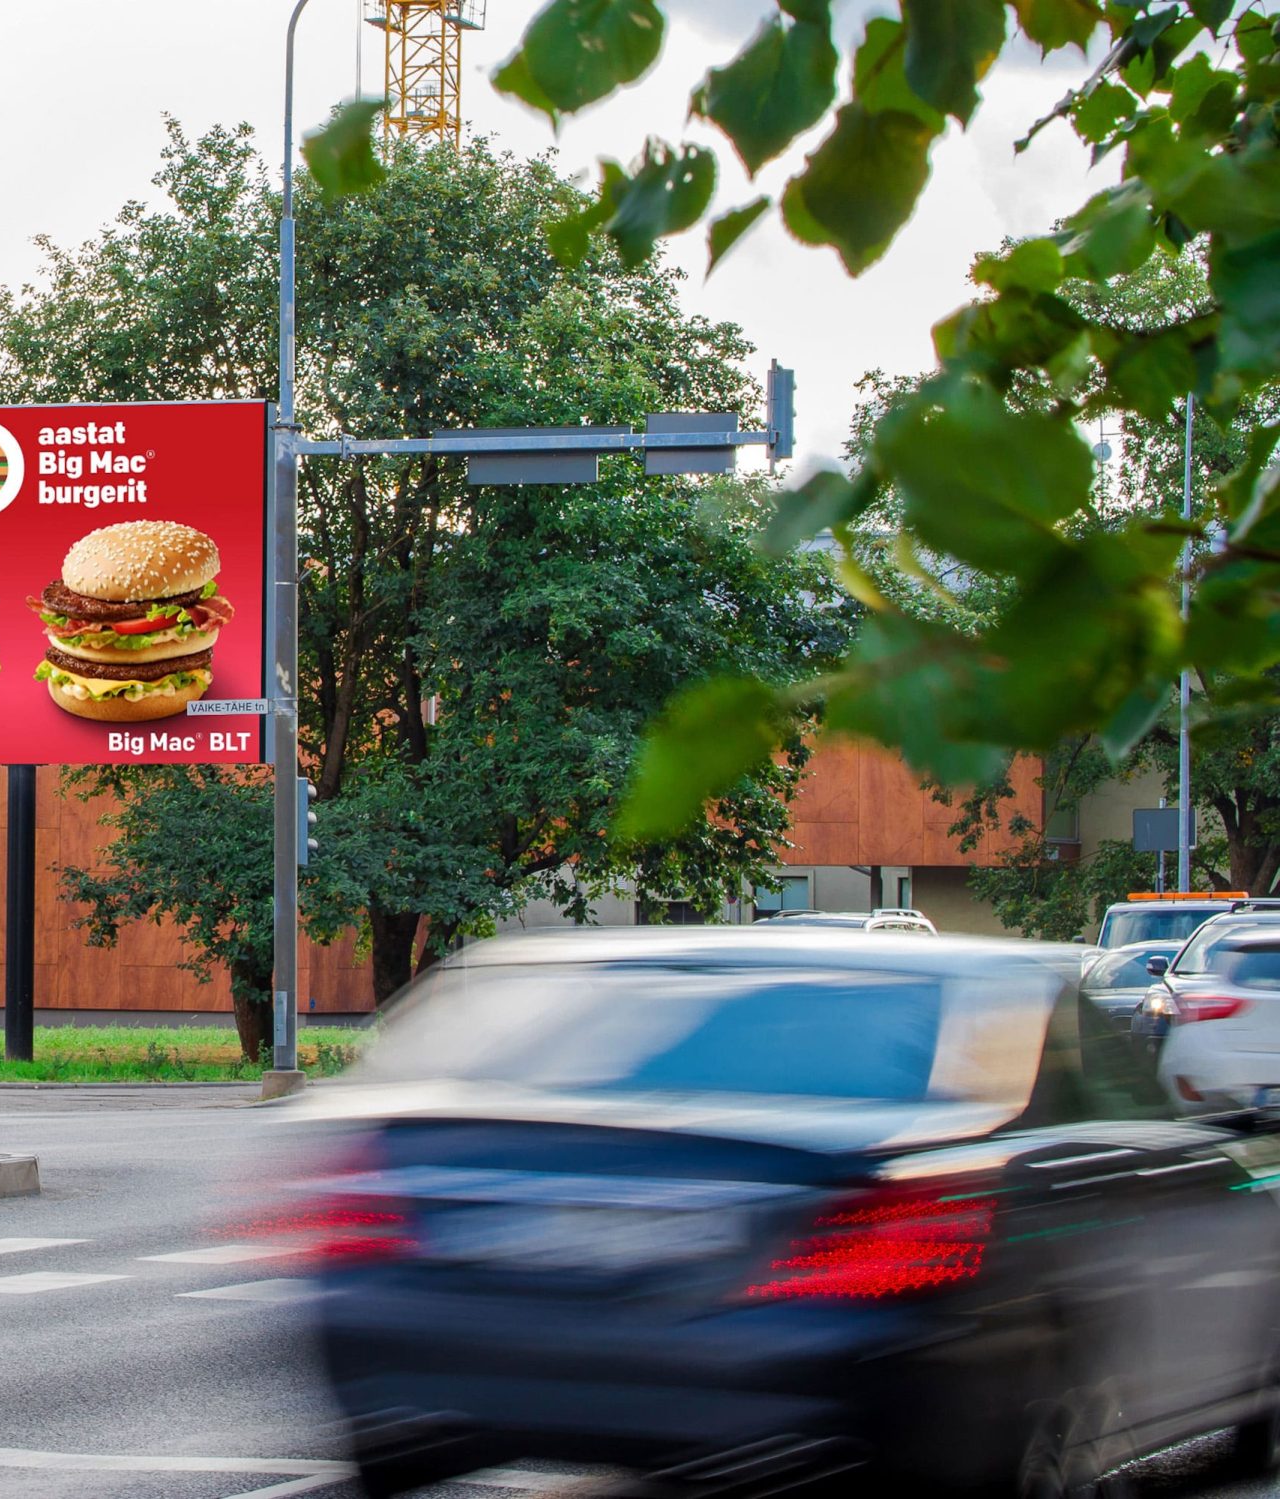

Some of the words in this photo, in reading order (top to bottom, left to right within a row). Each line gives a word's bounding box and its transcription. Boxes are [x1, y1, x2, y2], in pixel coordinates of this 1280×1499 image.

[38, 421, 126, 445] aastat
[38, 451, 83, 479] Big
[38, 479, 148, 508] burgerit
[190, 701, 252, 713] VÄIKE-TÄHE
[255, 703, 265, 712] tn
[108, 732, 144, 755] Big
[209, 732, 251, 751] BLT
